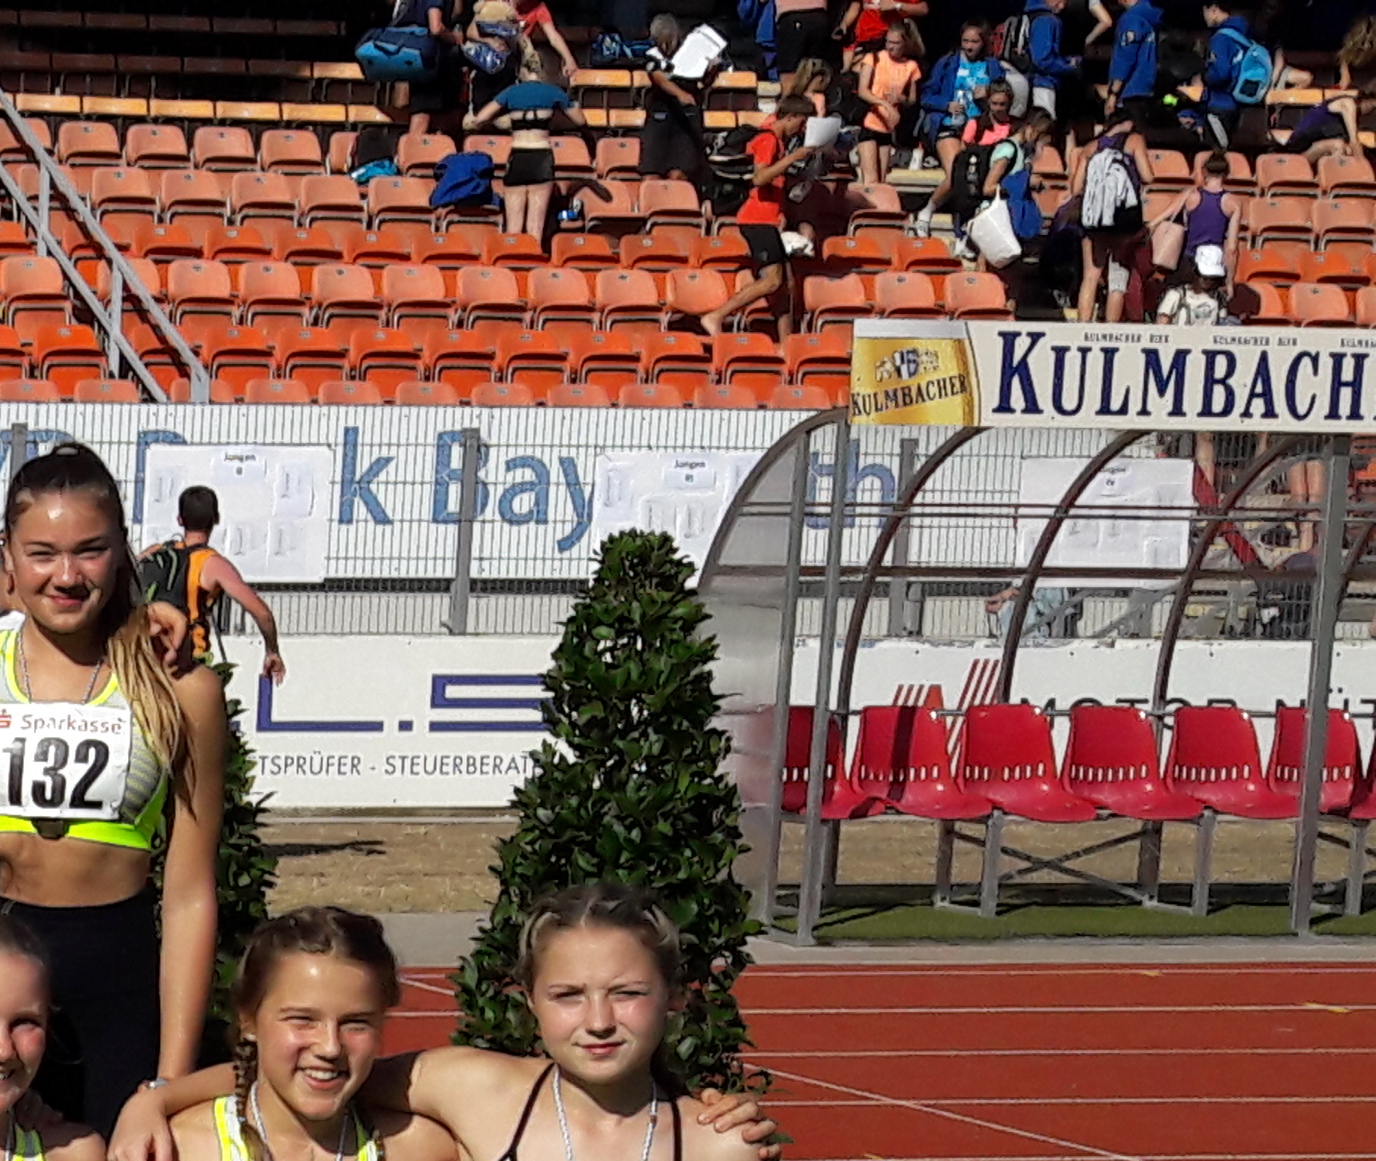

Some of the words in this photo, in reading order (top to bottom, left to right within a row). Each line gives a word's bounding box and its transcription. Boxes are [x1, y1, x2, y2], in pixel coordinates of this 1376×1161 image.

[851, 373, 968, 416] KULMBACHER
[992, 331, 1376, 421] KULMBACH
[20, 714, 123, 735] Sparkasse
[2, 736, 110, 810] 132
